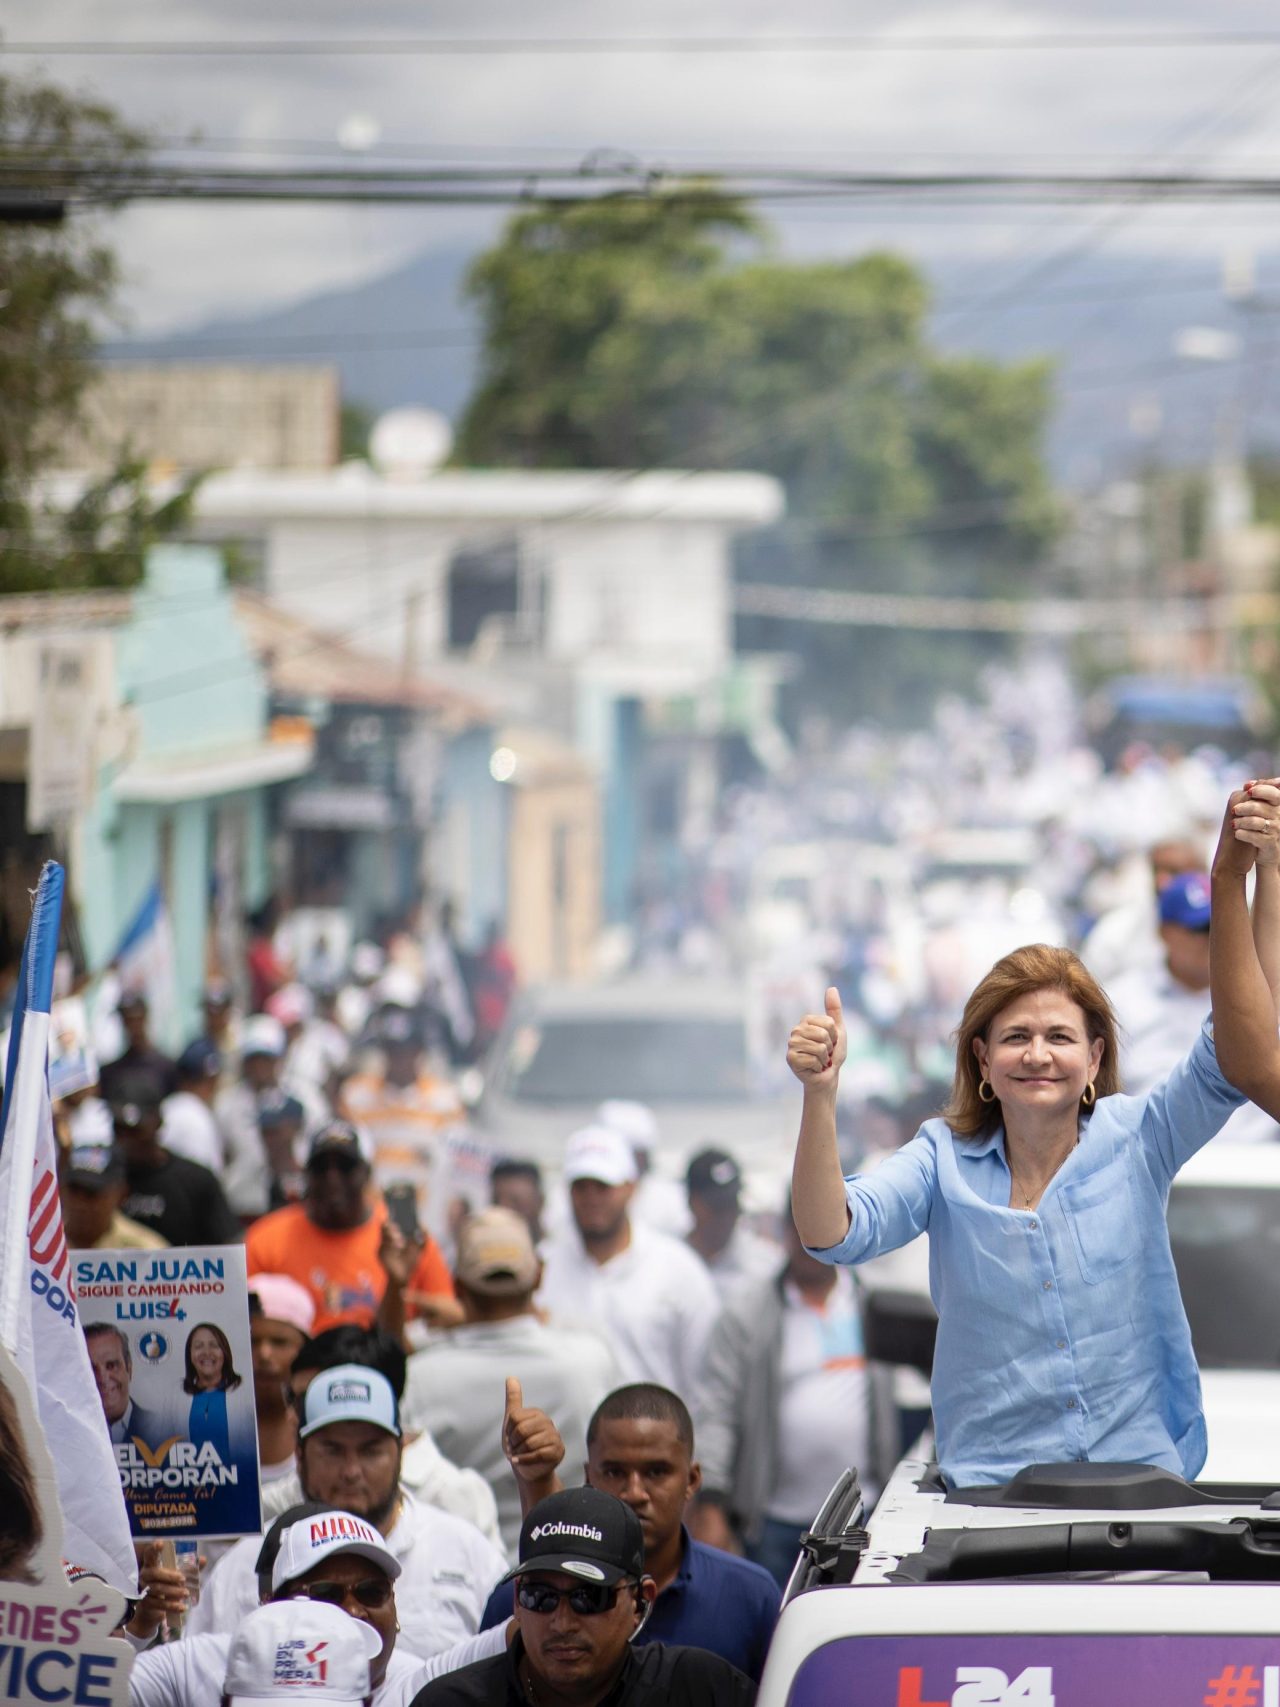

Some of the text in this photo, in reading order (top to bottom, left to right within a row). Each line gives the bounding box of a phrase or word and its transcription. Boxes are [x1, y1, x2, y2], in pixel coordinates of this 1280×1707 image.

[77, 1258, 225, 1283] SAN JUAN
[78, 1282, 225, 1298] SIGUE CAMBIANDO
[112, 1435, 223, 1468] ELVIRA
[119, 1462, 238, 1489] ORPORÁN
[134, 1502, 197, 1516] DIPUTADA
[541, 1521, 603, 1542] Columbia
